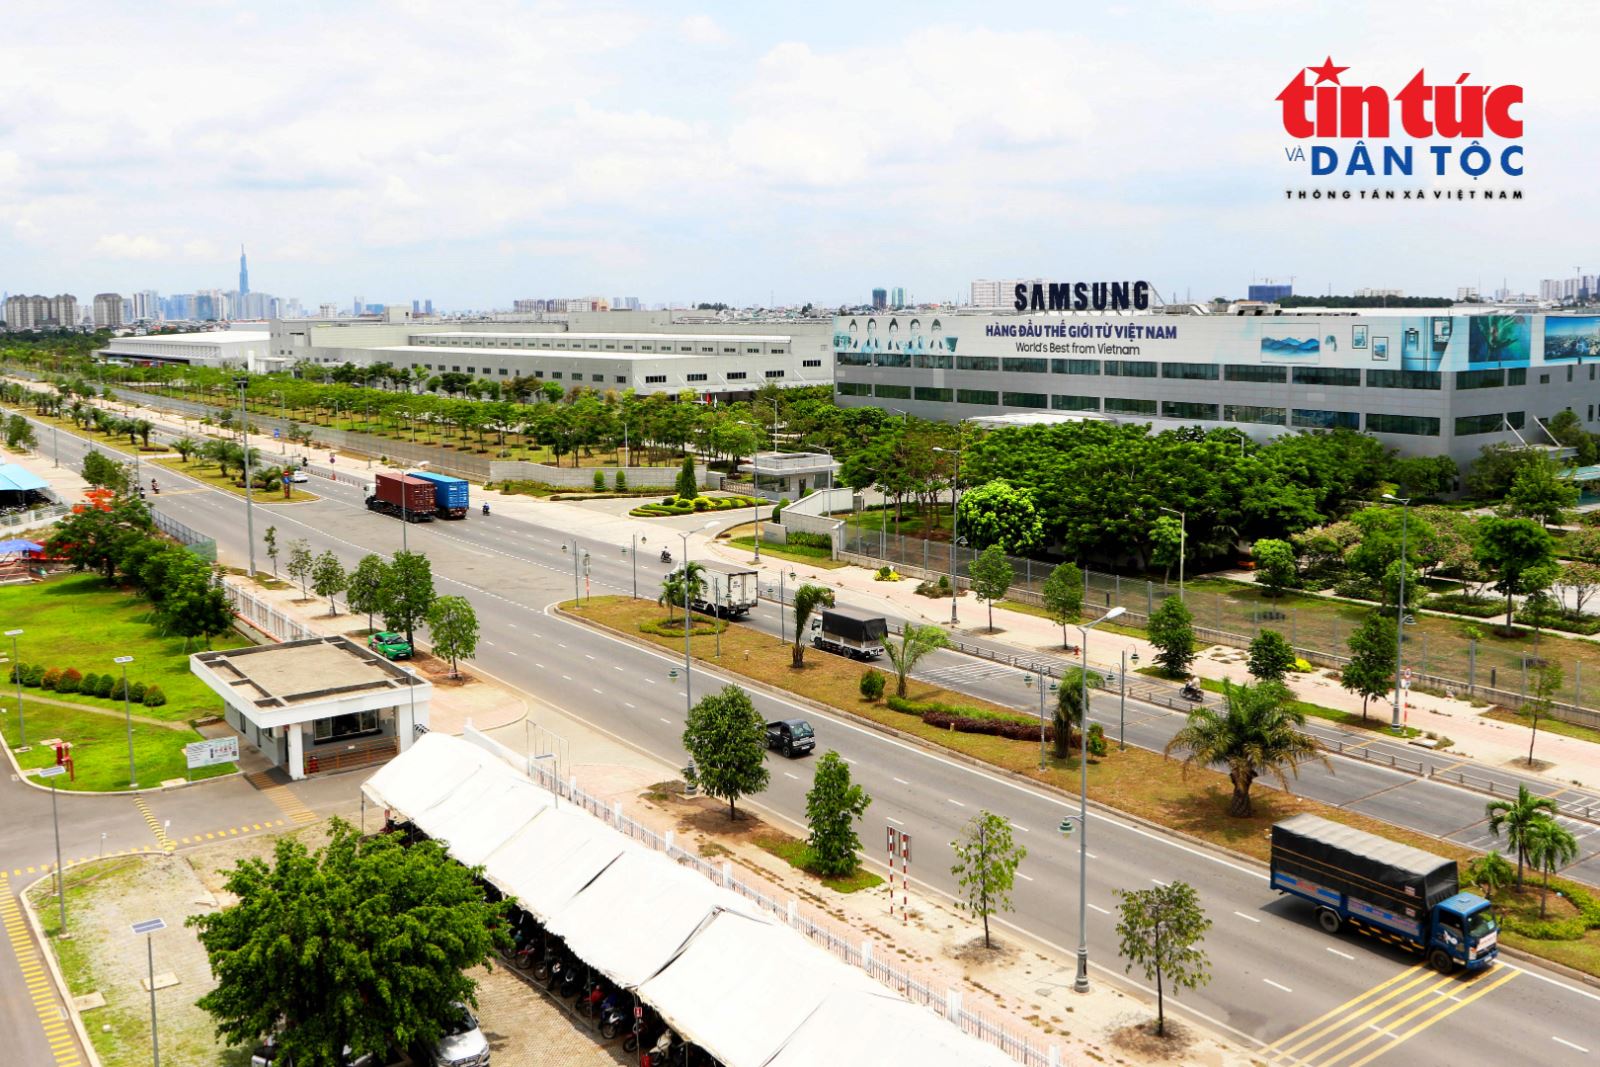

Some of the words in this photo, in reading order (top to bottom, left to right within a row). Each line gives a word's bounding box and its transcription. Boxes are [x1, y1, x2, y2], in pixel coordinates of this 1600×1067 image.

[1014, 281, 1149, 311] SAMSUNG
[985, 322, 1017, 337] HÀNG
[1018, 319, 1043, 338] ĐẦU
[1044, 319, 1067, 338] THẾ
[1068, 322, 1093, 338] GIỚI
[1095, 322, 1113, 339] TỪ
[1114, 322, 1144, 342] VIỆT
[1145, 325, 1177, 339] NAM
[1015, 342, 1048, 353] World's
[1049, 342, 1070, 354] Best
[1072, 342, 1096, 355] from
[1098, 343, 1140, 355] Vietnam
